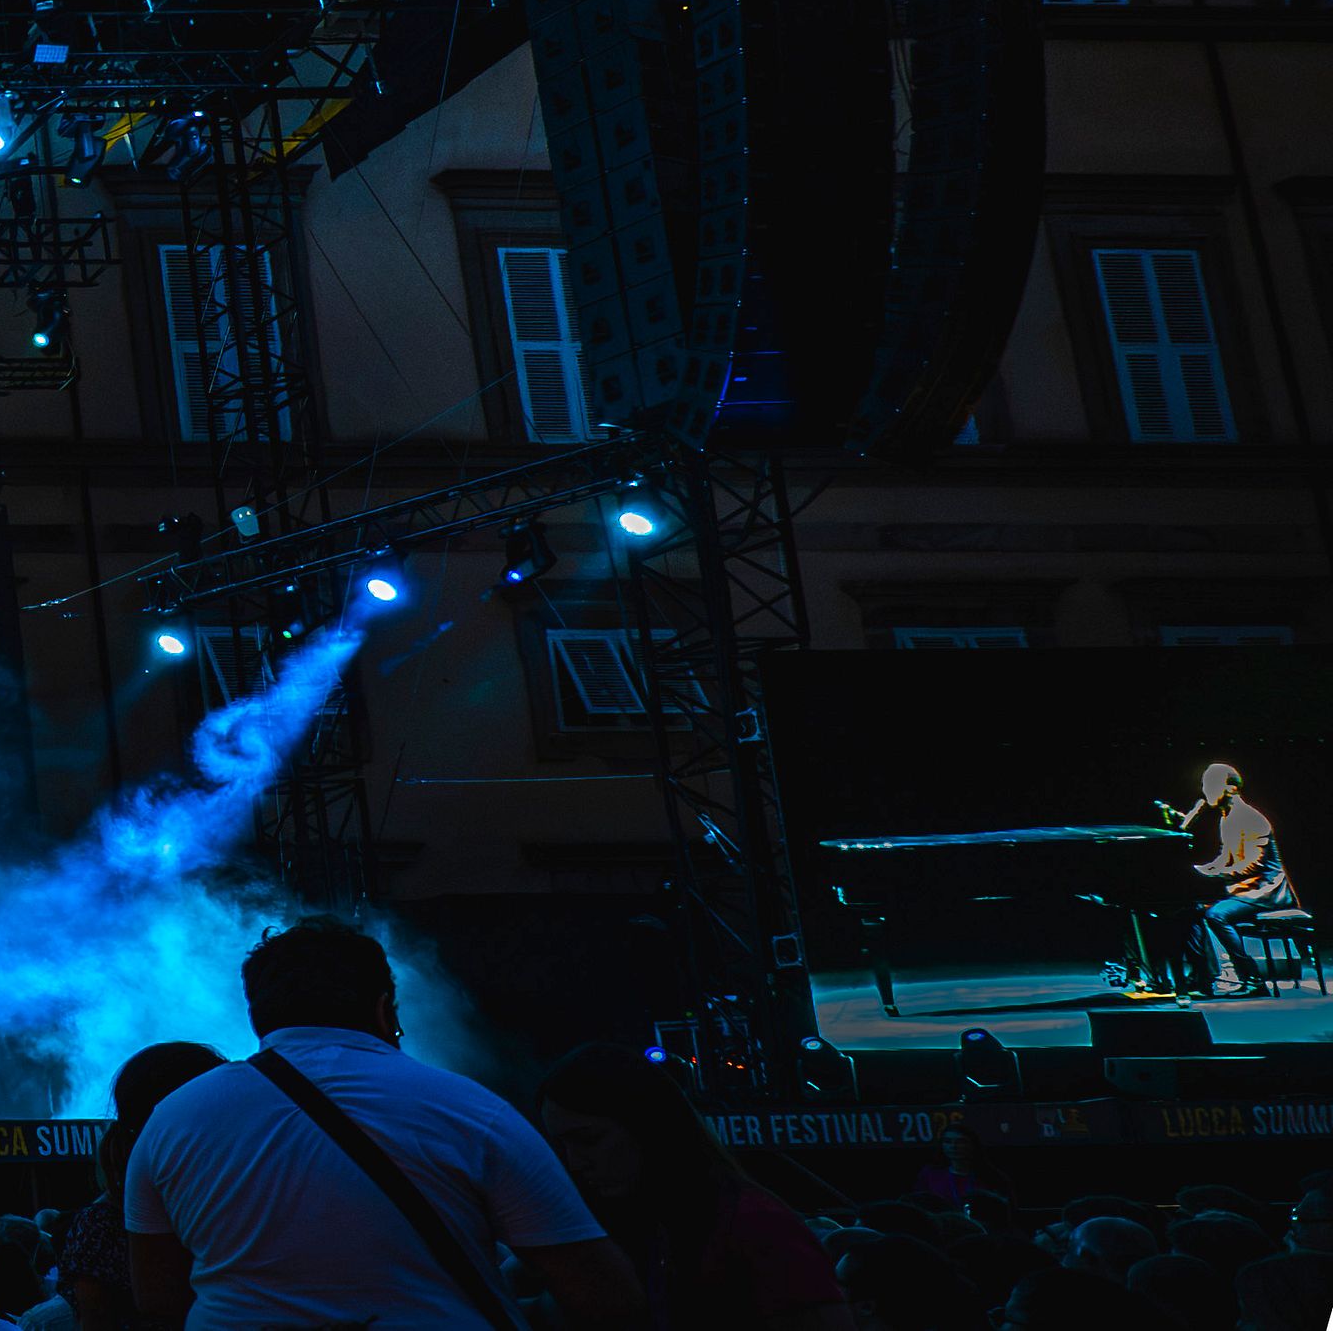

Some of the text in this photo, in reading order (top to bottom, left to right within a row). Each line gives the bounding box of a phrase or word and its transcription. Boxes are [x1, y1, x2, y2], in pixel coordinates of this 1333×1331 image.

[769, 1113, 893, 1145] FESTIVAL
[1161, 1103, 1333, 1138] LUCCA SUMM
[36, 1125, 106, 1156] SUM
